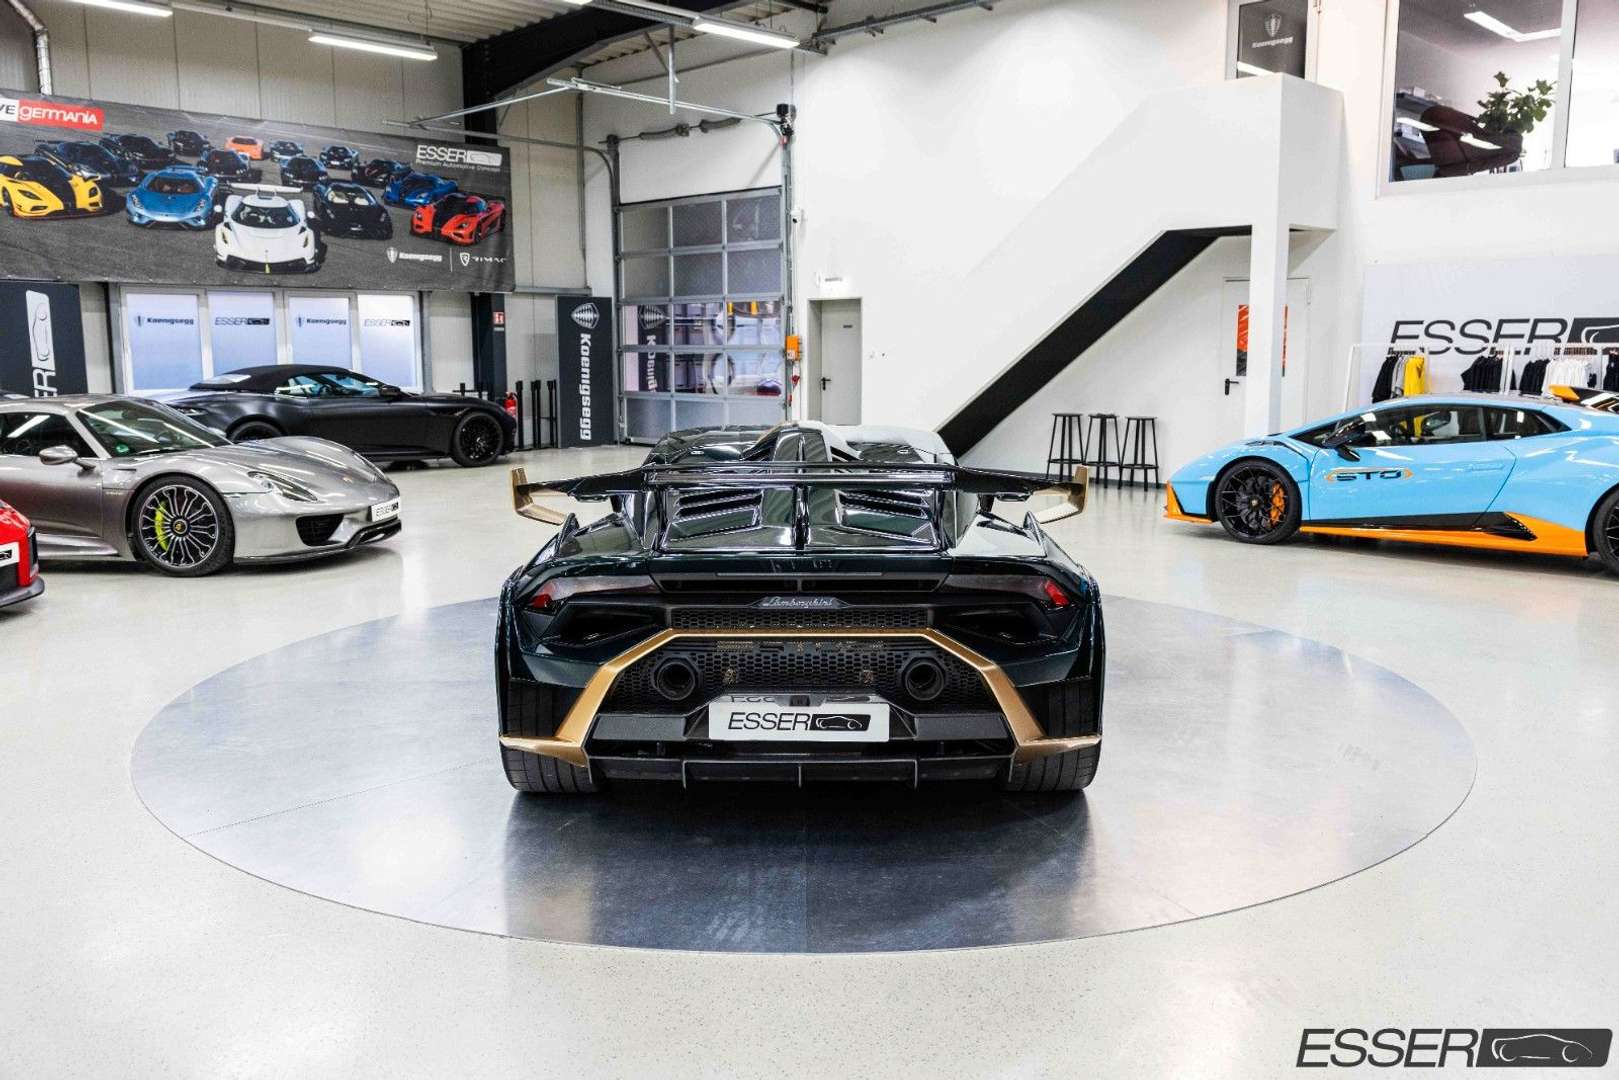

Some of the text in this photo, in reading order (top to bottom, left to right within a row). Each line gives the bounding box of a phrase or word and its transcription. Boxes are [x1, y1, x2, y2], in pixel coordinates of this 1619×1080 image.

[416, 144, 467, 163] ESSER
[1388, 318, 1568, 356] ESSER
[580, 333, 592, 441] Koenigsegg
[762, 595, 833, 609] Lamborghini
[727, 712, 811, 731] ESSER
